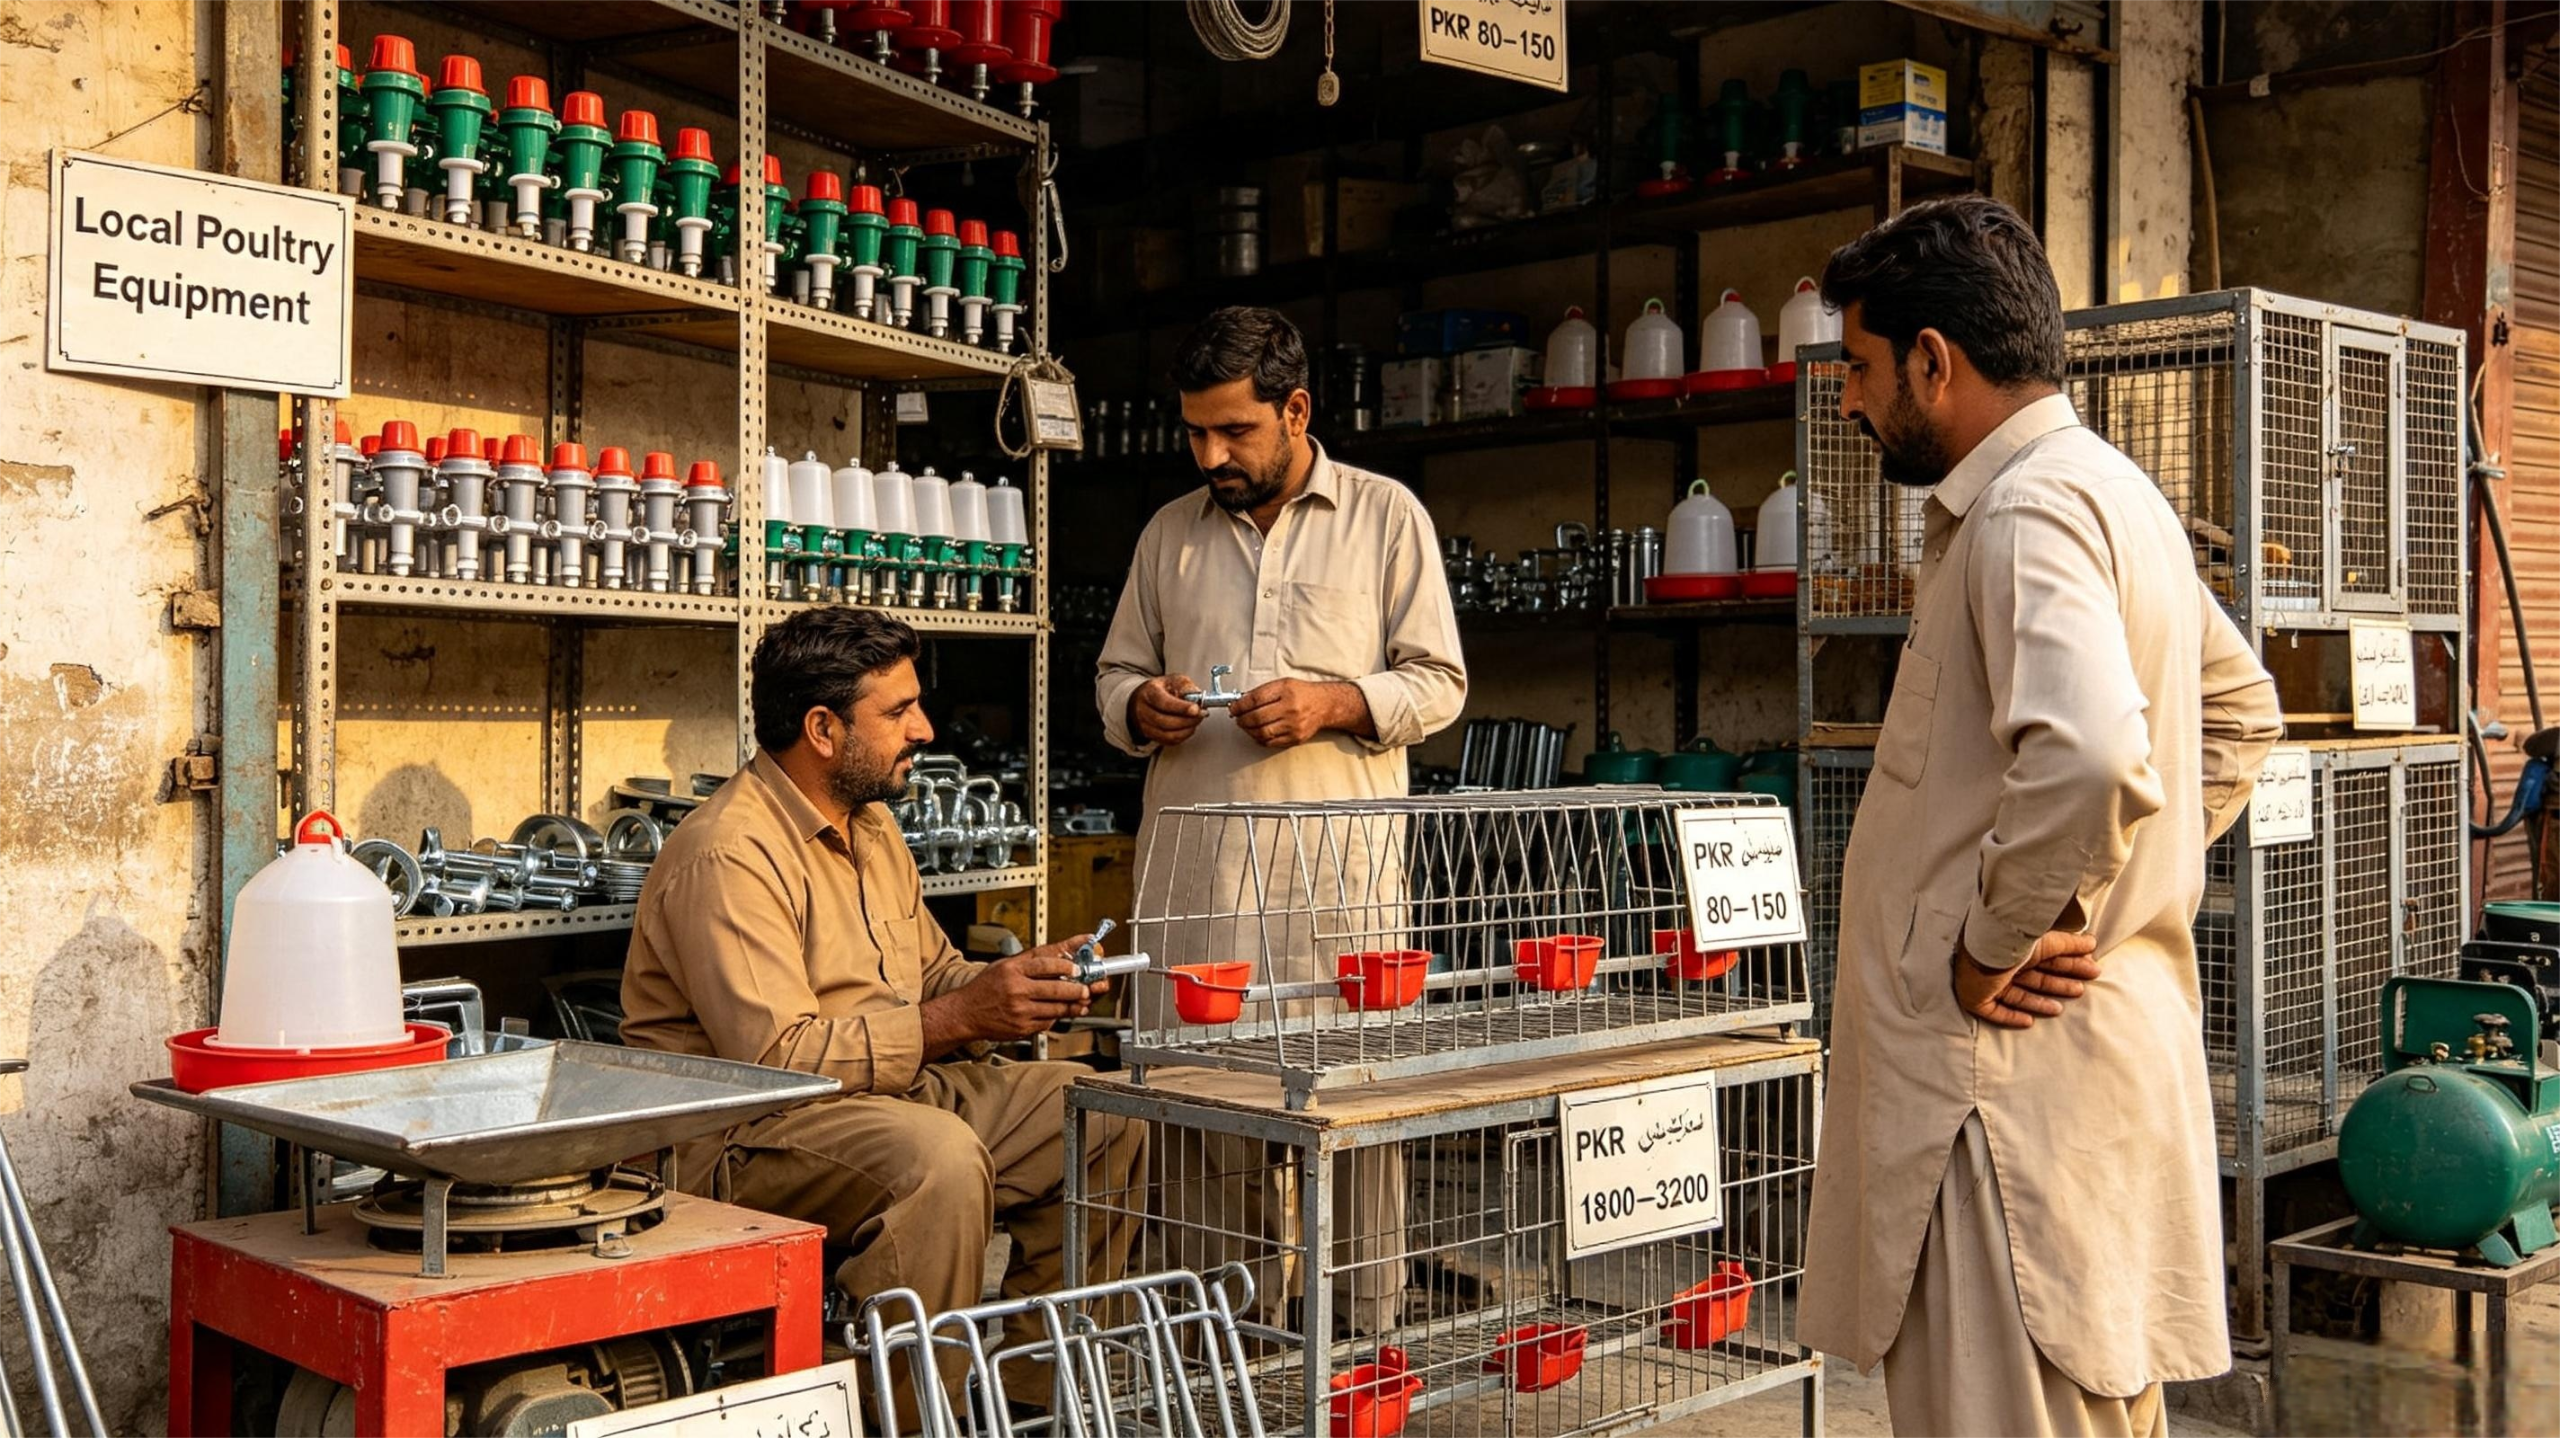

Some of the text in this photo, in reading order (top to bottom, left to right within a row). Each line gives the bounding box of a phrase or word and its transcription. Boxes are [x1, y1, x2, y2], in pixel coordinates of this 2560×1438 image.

[1431, 7, 1470, 41] PKR
[75, 196, 335, 275] Local Poultry
[93, 262, 311, 325] Equipment
[1694, 842, 1735, 870] PKR
[1576, 1125, 1626, 1162] PKR
